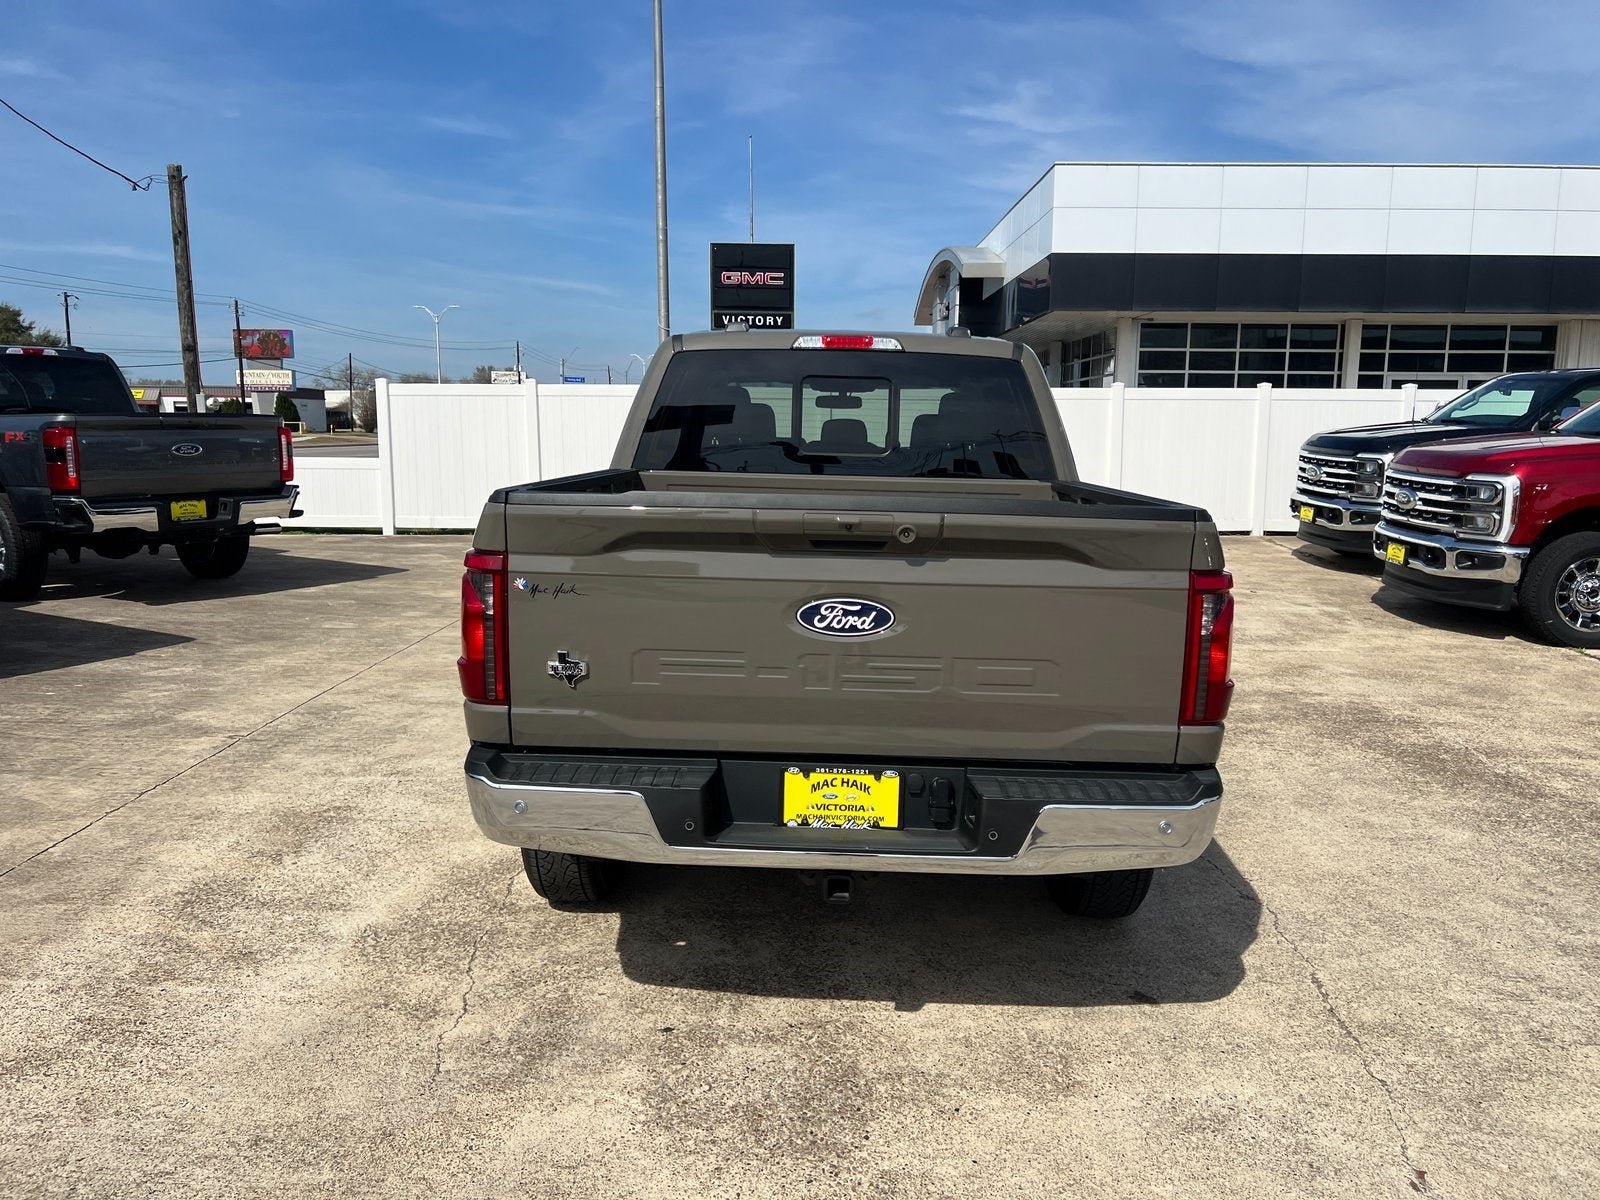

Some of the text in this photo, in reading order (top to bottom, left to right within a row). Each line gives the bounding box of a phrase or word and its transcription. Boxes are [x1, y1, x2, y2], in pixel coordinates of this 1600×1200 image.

[721, 271, 784, 285] GMC
[722, 315, 783, 326] VICTORY
[529, 582, 590, 600] Mac Haik
[813, 603, 877, 630] Ford
[630, 648, 1060, 697] F-150
[810, 777, 871, 796] MAC HAIK
[815, 803, 866, 813] VICTORIA
[809, 818, 874, 830] Mac Haik
